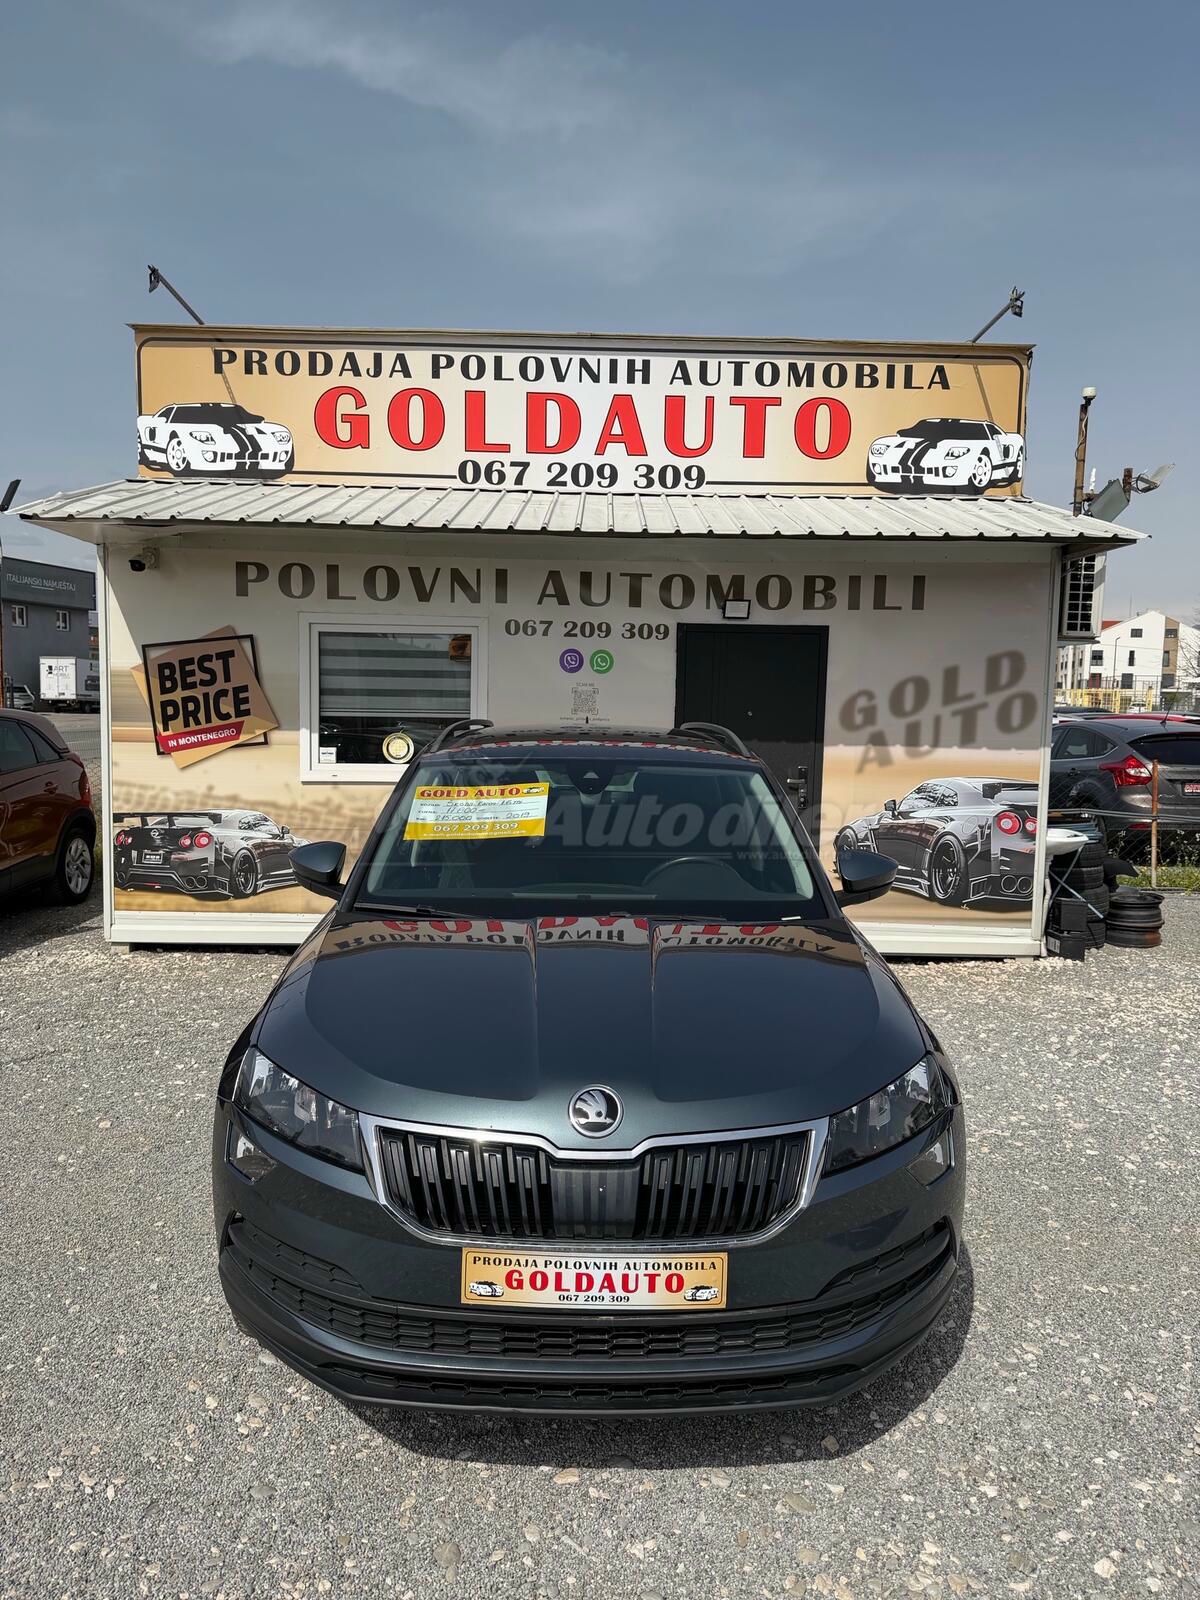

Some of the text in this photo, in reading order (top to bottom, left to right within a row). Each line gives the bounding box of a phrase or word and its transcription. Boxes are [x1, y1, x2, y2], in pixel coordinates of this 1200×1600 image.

[213, 348, 951, 391] PRODAJA POLOVNIH AUTOMOBILA
[313, 385, 852, 461] GOLDAUTO
[457, 459, 706, 490] 067 209 309
[235, 560, 927, 612] POLOVNI AUTOMOBILI
[504, 618, 670, 640] 067 209 309
[157, 649, 236, 696] BEST
[838, 649, 1027, 734] GOLD
[159, 684, 251, 732] PRICE
[168, 727, 237, 748] IN MONTENEGRO
[855, 690, 1039, 775] AUTO
[420, 786, 521, 798] GOLD AUTO
[464, 824, 489, 832] 209
[494, 822, 519, 830] 309
[472, 1255, 718, 1272] PRODAJA POLOVNIH AUTOMOBILA
[505, 1269, 685, 1294] GOLDAUTO
[558, 1293, 630, 1304] 067 209 309
